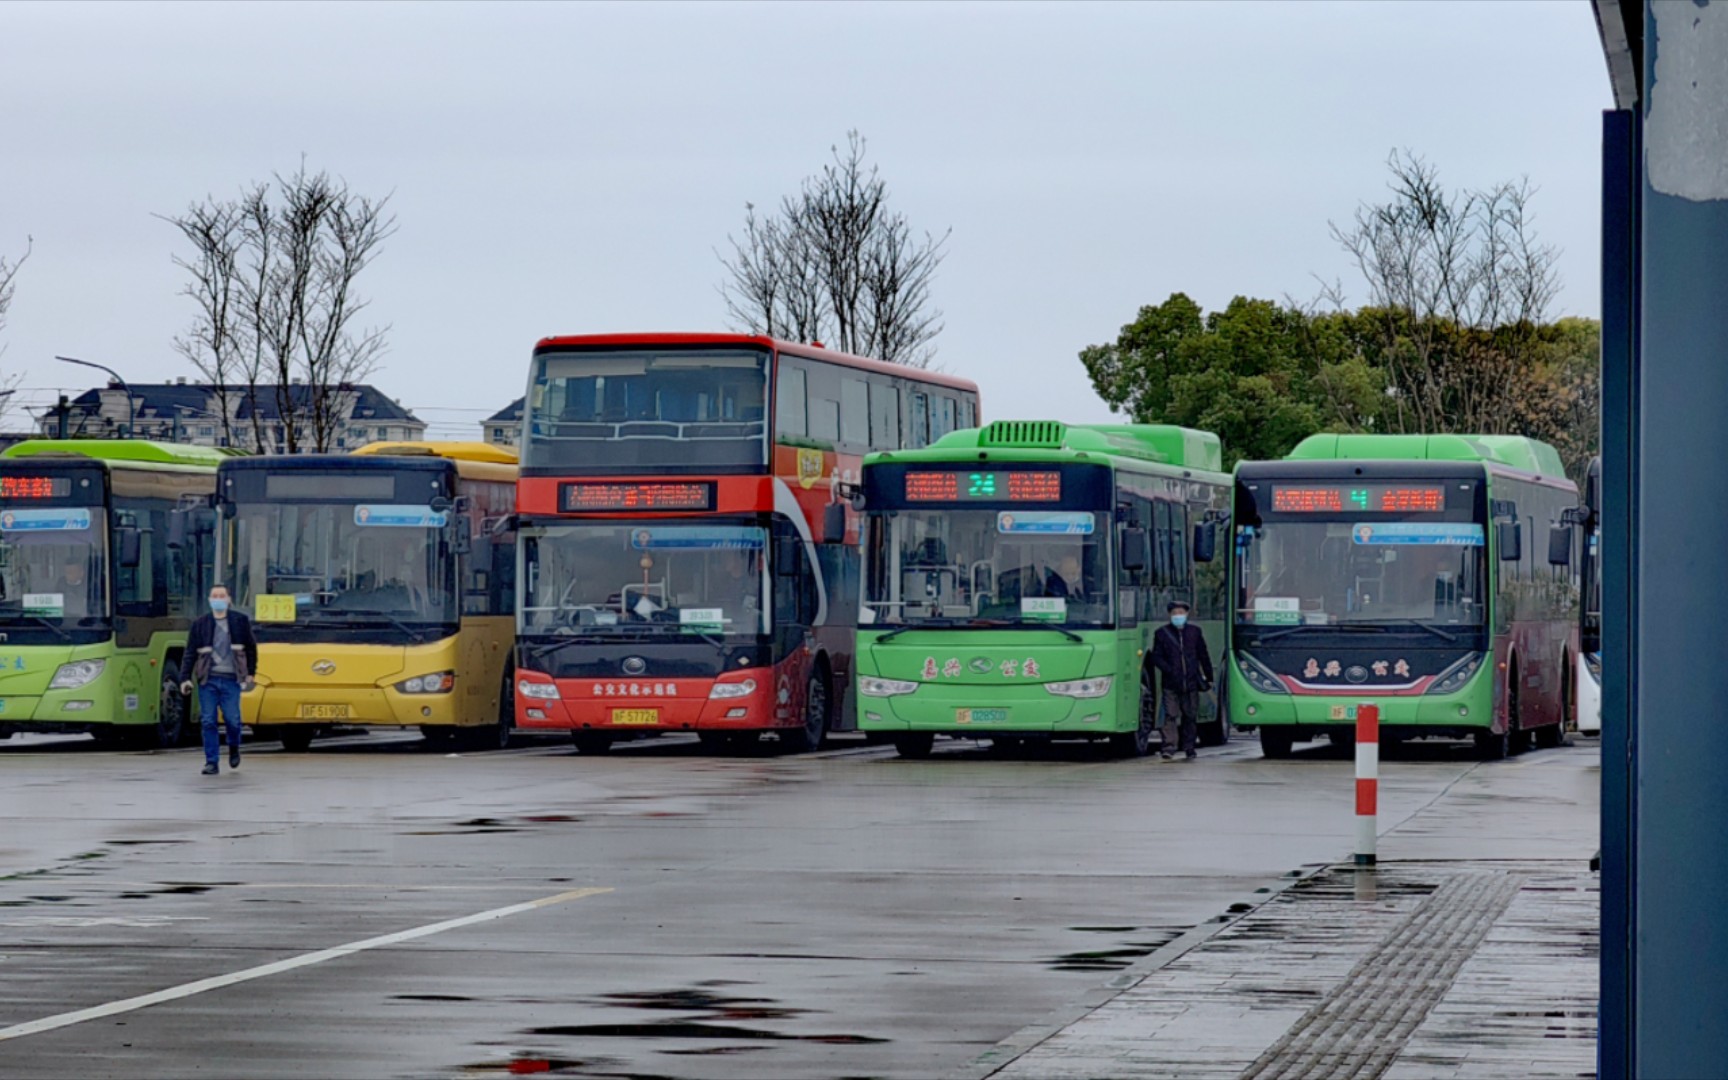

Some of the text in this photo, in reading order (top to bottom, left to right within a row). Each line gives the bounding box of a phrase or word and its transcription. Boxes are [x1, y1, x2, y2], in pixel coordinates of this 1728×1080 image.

[968, 473, 995, 496] 24
[1351, 490, 1367, 509] 4
[260, 603, 292, 619] 212
